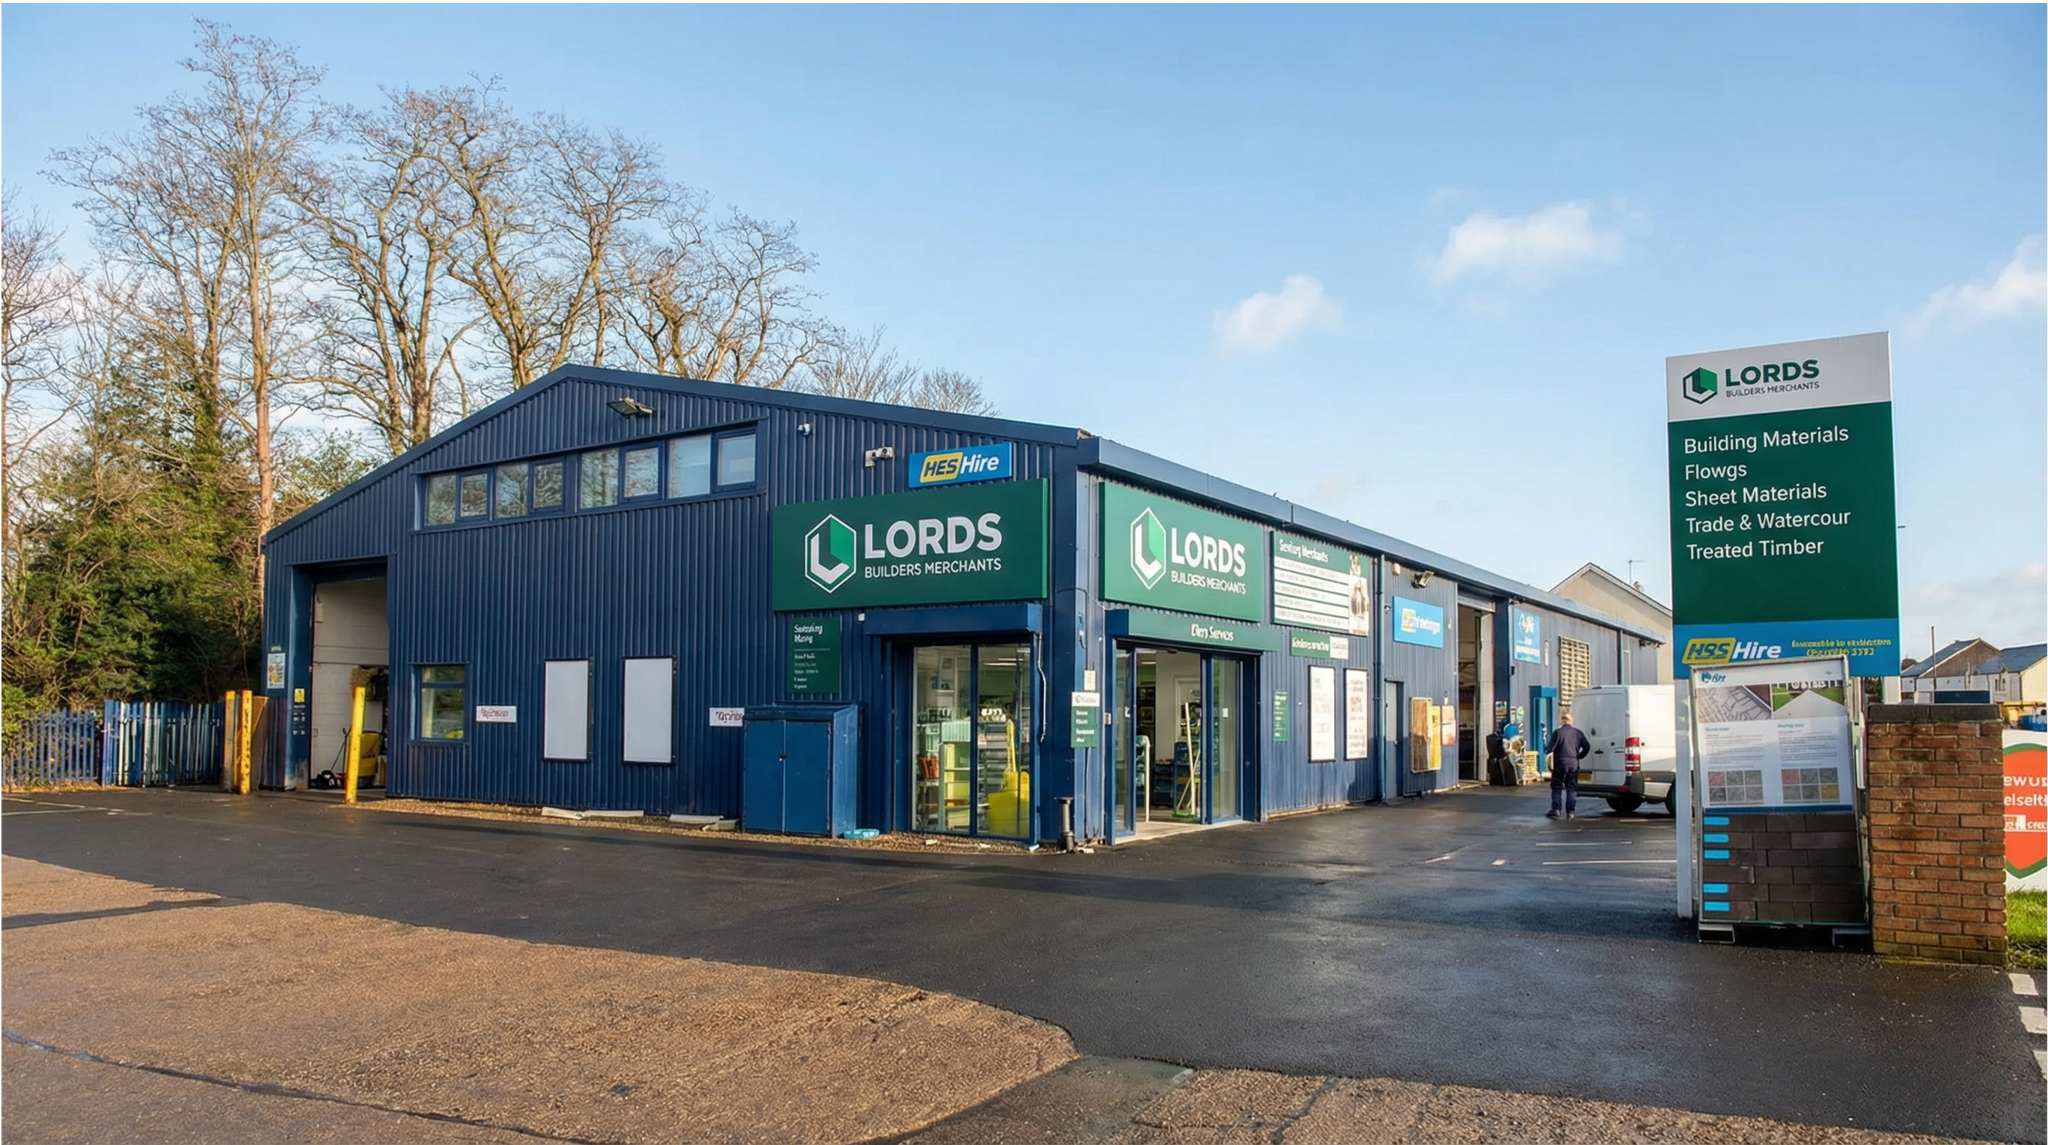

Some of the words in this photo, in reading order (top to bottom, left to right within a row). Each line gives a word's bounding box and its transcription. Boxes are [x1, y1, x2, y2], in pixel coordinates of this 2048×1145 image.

[1725, 359, 1820, 387] LORDS
[1684, 435, 1757, 454] Building
[1763, 425, 1849, 447] Materials
[1685, 463, 1748, 482] Flowgs
[1685, 489, 1737, 508] Sheet
[1742, 482, 1827, 503] Materials
[1686, 515, 1734, 533] Trade
[1740, 514, 1752, 531] &
[1757, 510, 1851, 529] Watercour
[864, 513, 1003, 559] LORDS
[1170, 527, 1246, 577] LORDS
[1686, 541, 1753, 560] Treated
[1758, 539, 1824, 557] Timber
[864, 562, 922, 579] BUILDERS
[924, 557, 1002, 575] MERCHANTS
